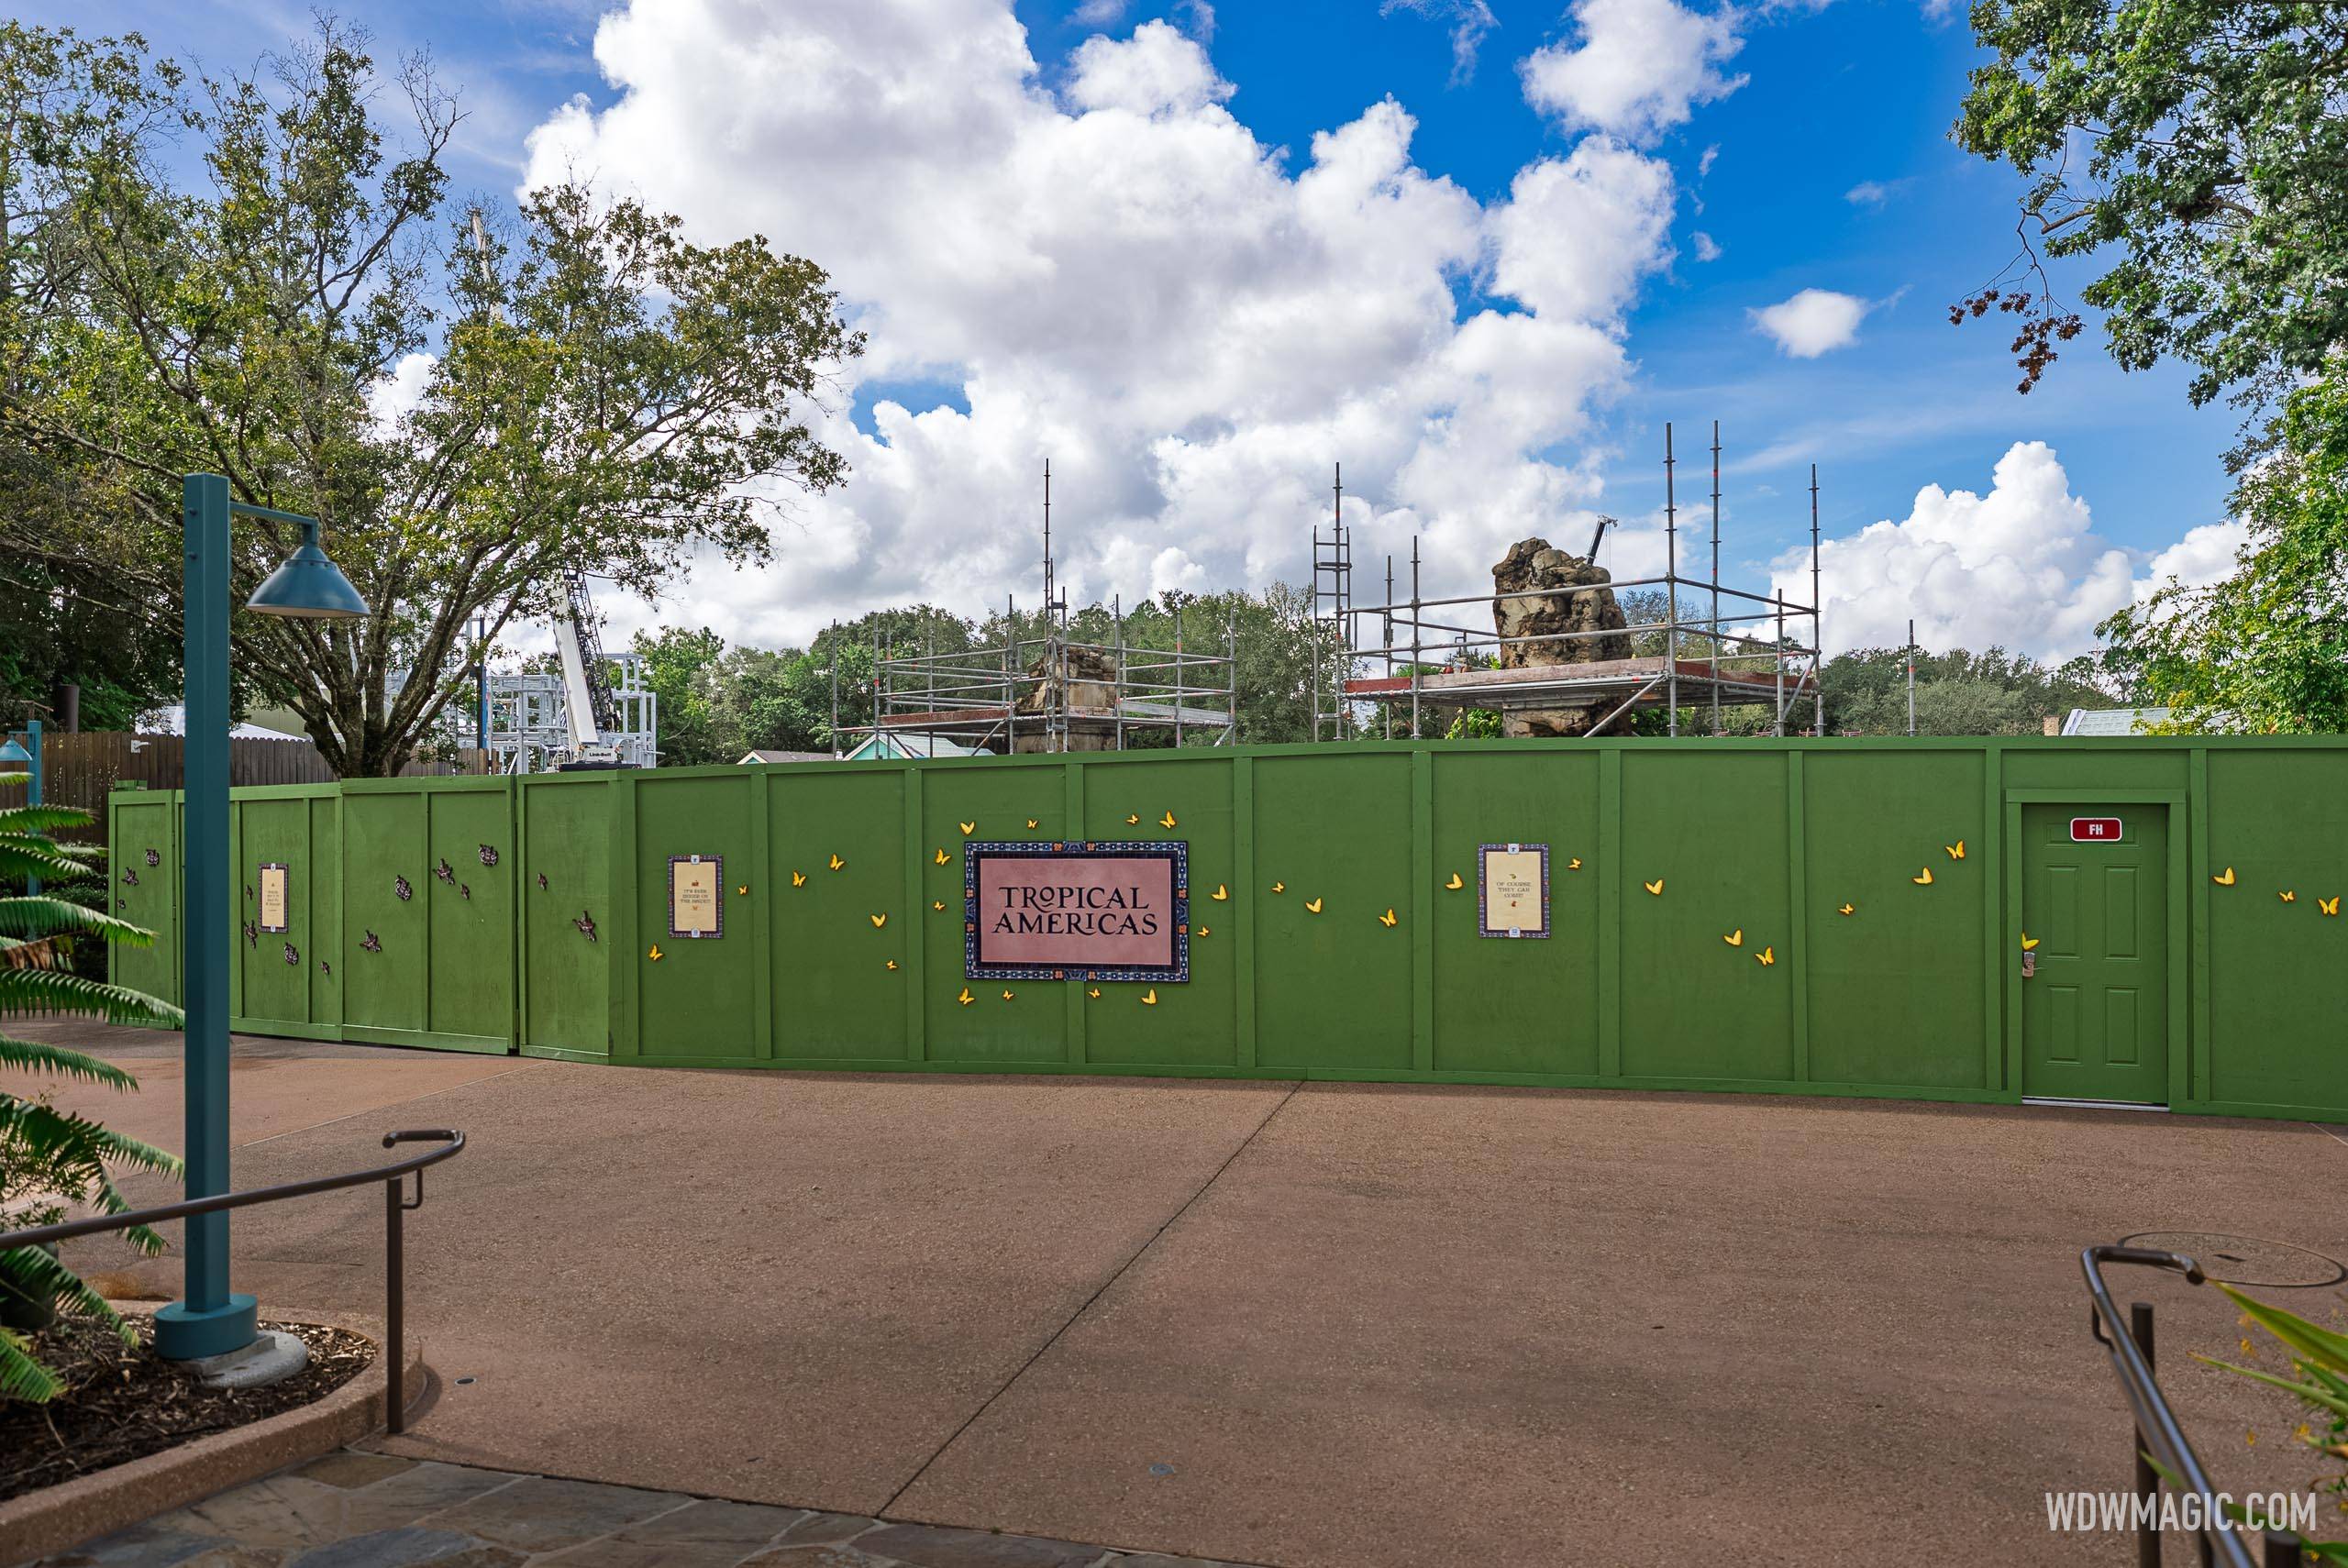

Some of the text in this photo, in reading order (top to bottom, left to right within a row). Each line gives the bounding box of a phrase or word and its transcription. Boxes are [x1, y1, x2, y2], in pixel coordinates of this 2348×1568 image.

[2088, 823, 2103, 835] FH
[999, 886, 1150, 913] TROPICAL
[991, 911, 1158, 936] AMERICAS
